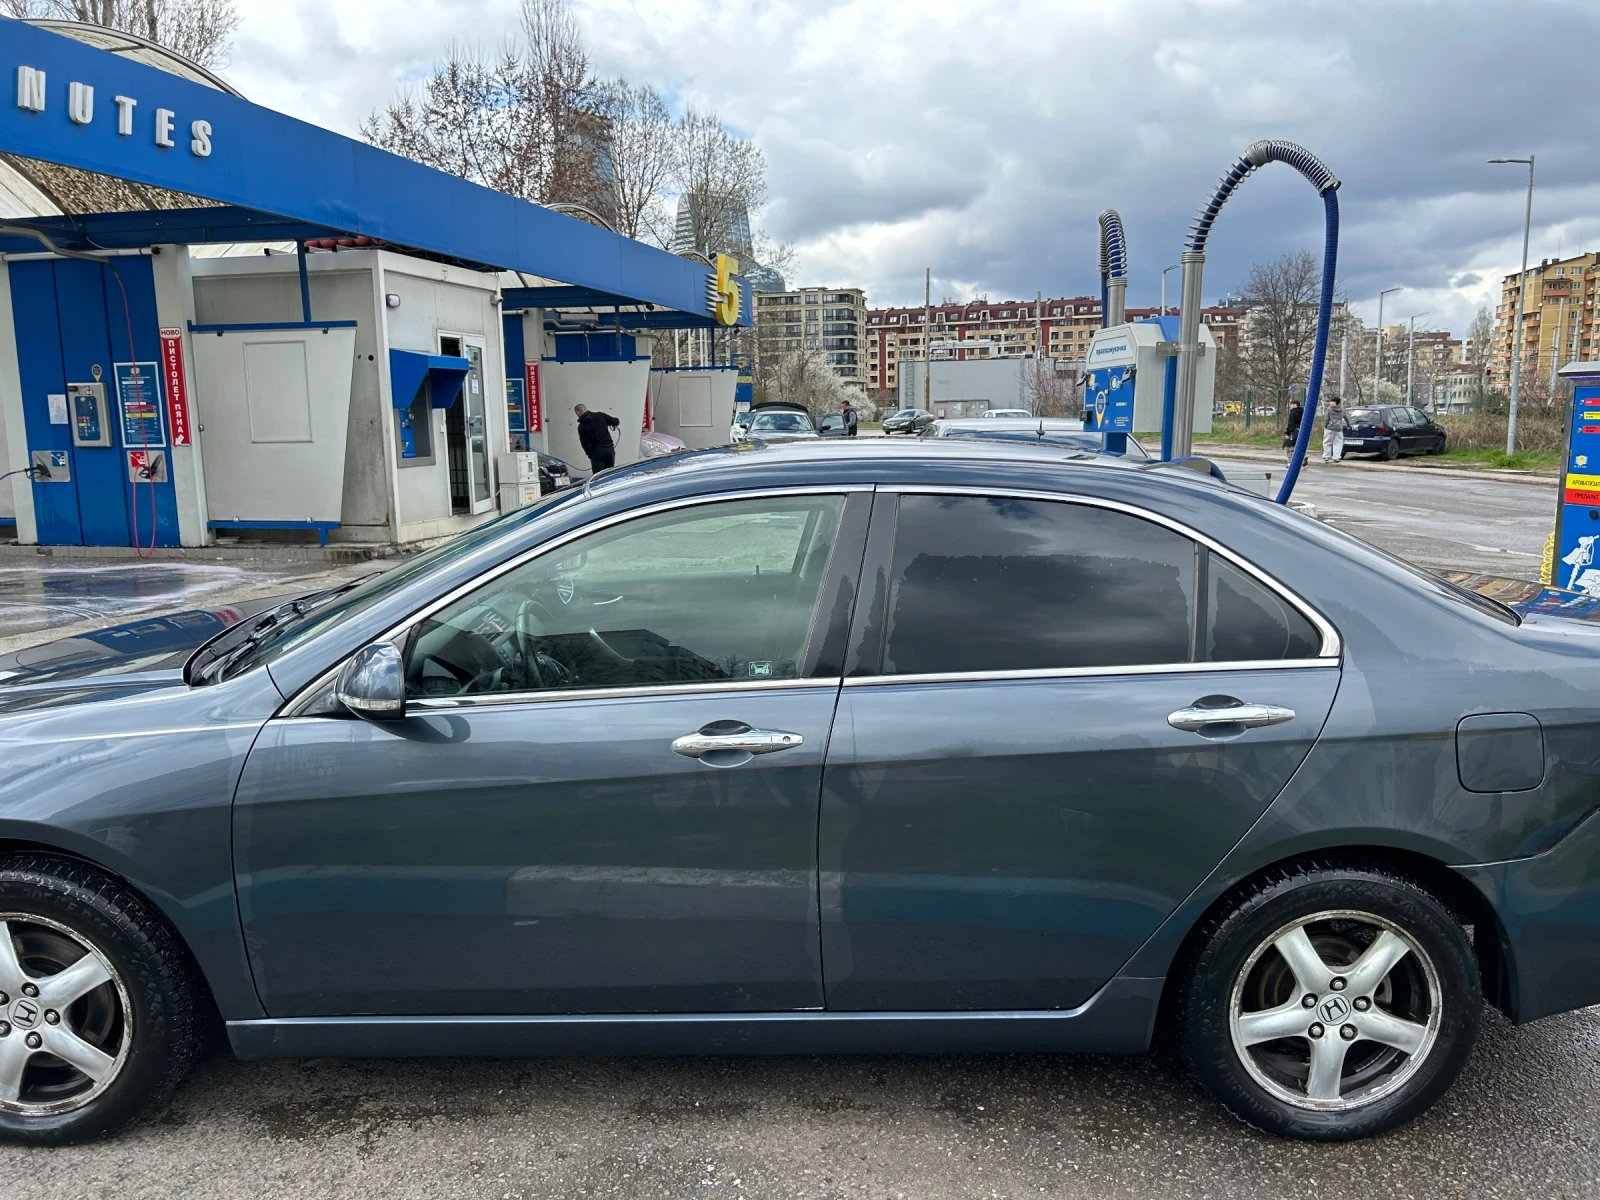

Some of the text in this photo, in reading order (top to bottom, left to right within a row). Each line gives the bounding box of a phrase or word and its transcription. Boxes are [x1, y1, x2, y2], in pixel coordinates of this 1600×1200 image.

[17, 65, 212, 157] NUTES
[716, 254, 740, 326] 5
[168, 340, 184, 433] ПИСТОЛЕТ ПЯНА
[1574, 492, 1599, 500] ПРЕПАРАТ
